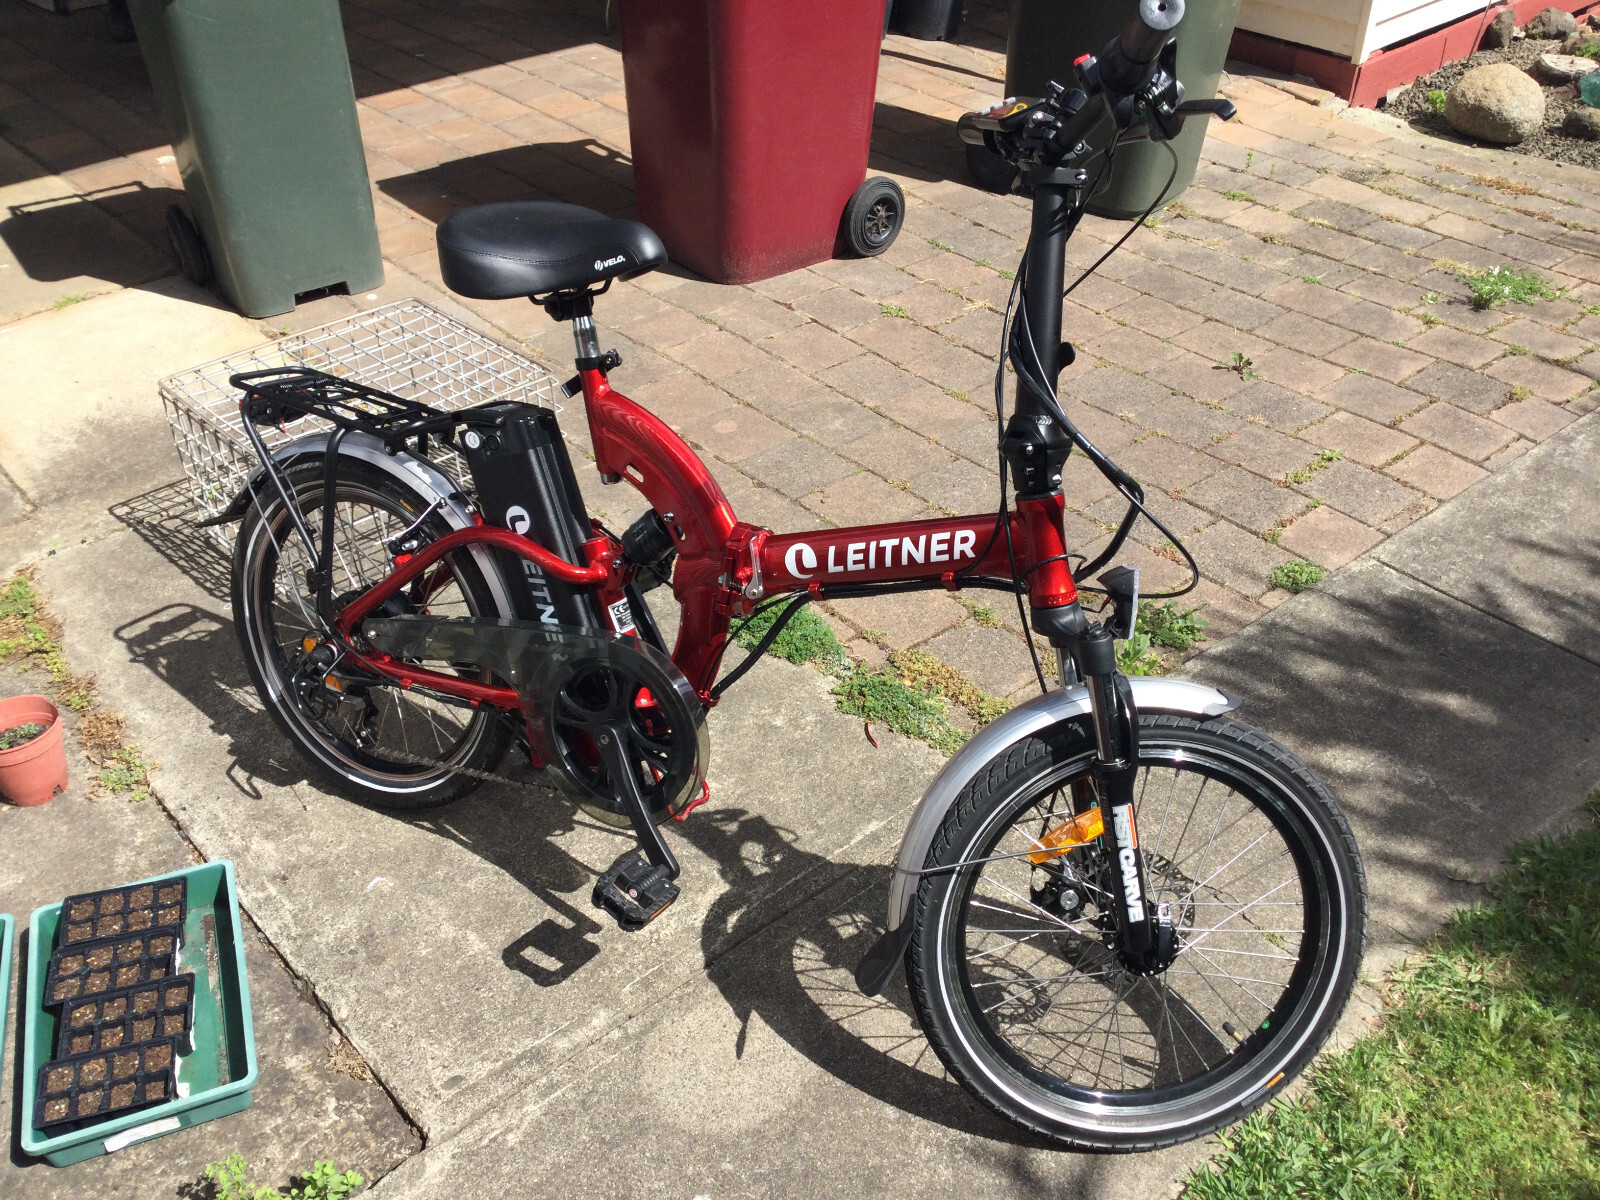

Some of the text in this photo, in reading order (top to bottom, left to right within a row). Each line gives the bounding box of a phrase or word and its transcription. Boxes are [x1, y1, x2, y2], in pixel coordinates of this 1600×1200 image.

[603, 255, 624, 268] VELO
[828, 529, 976, 573] LEITNER
[522, 558, 568, 662] EITNE
